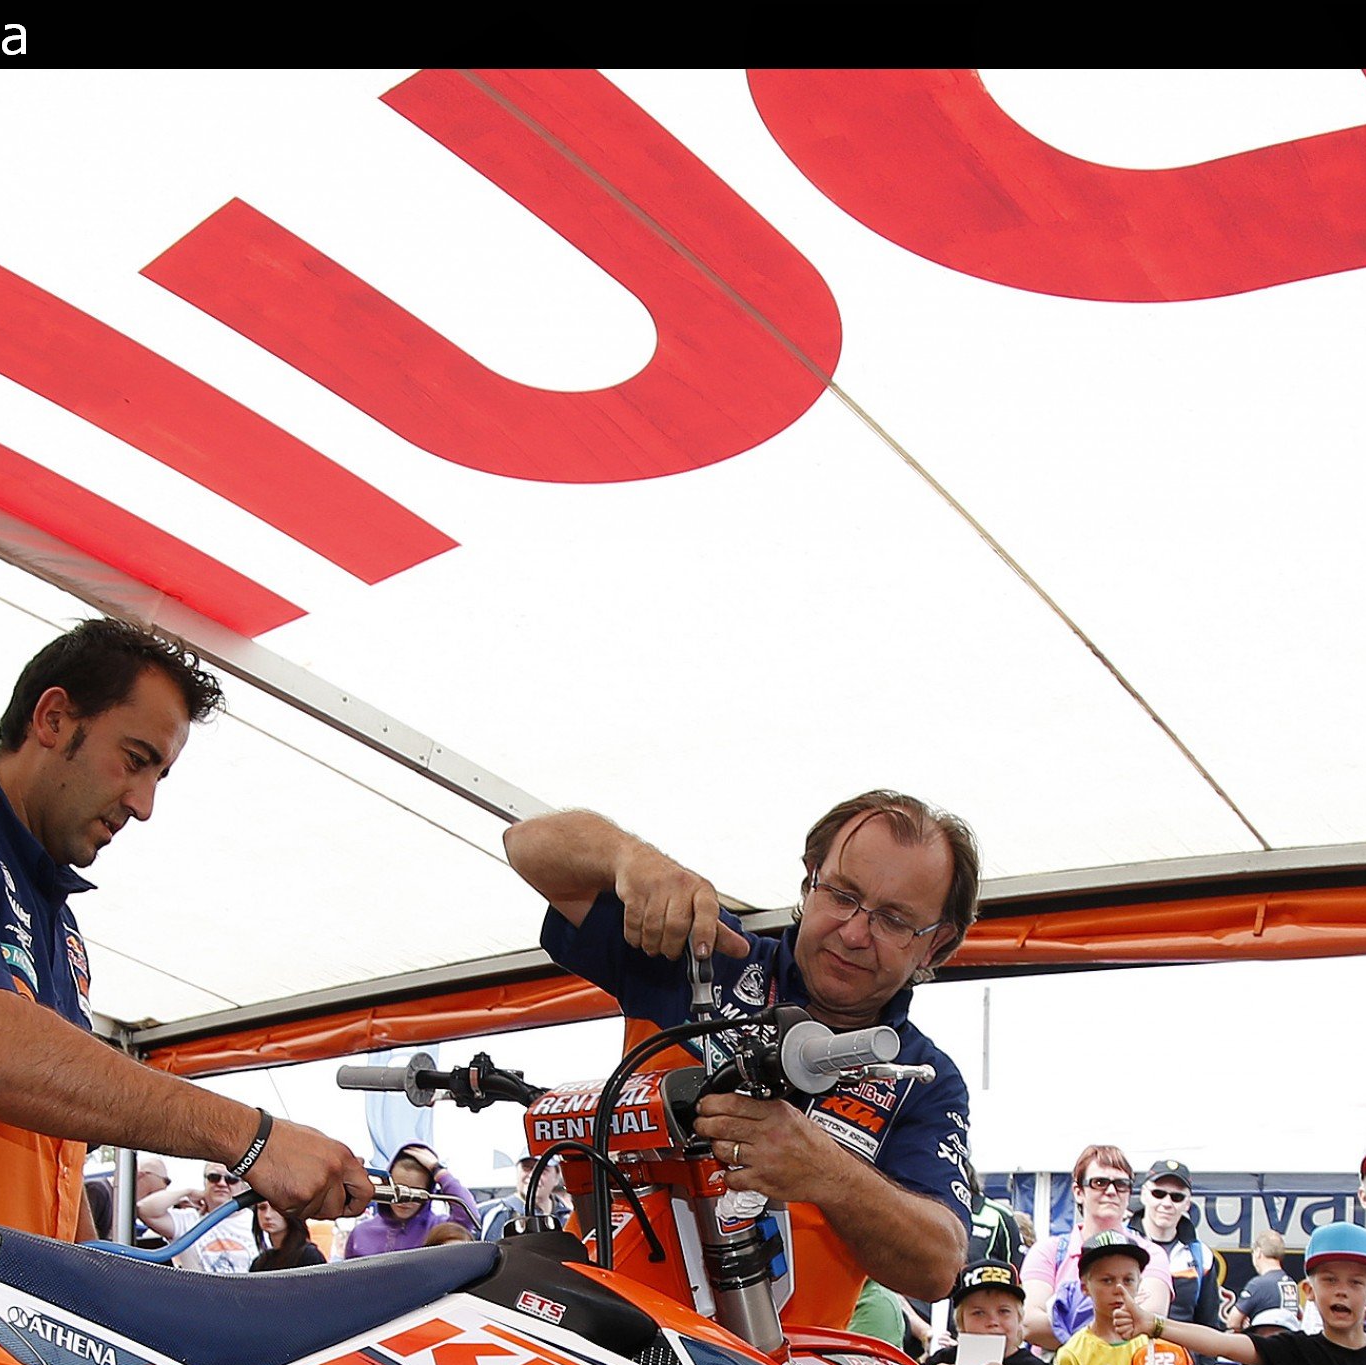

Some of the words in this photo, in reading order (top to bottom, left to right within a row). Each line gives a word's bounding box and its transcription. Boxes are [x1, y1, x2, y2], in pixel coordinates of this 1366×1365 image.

[532, 1084, 653, 1116] RENTAL
[820, 1095, 886, 1134] KTM
[812, 1114, 848, 1136] FACTORY
[848, 1129, 877, 1152] RACING
[521, 1293, 565, 1318] ETS
